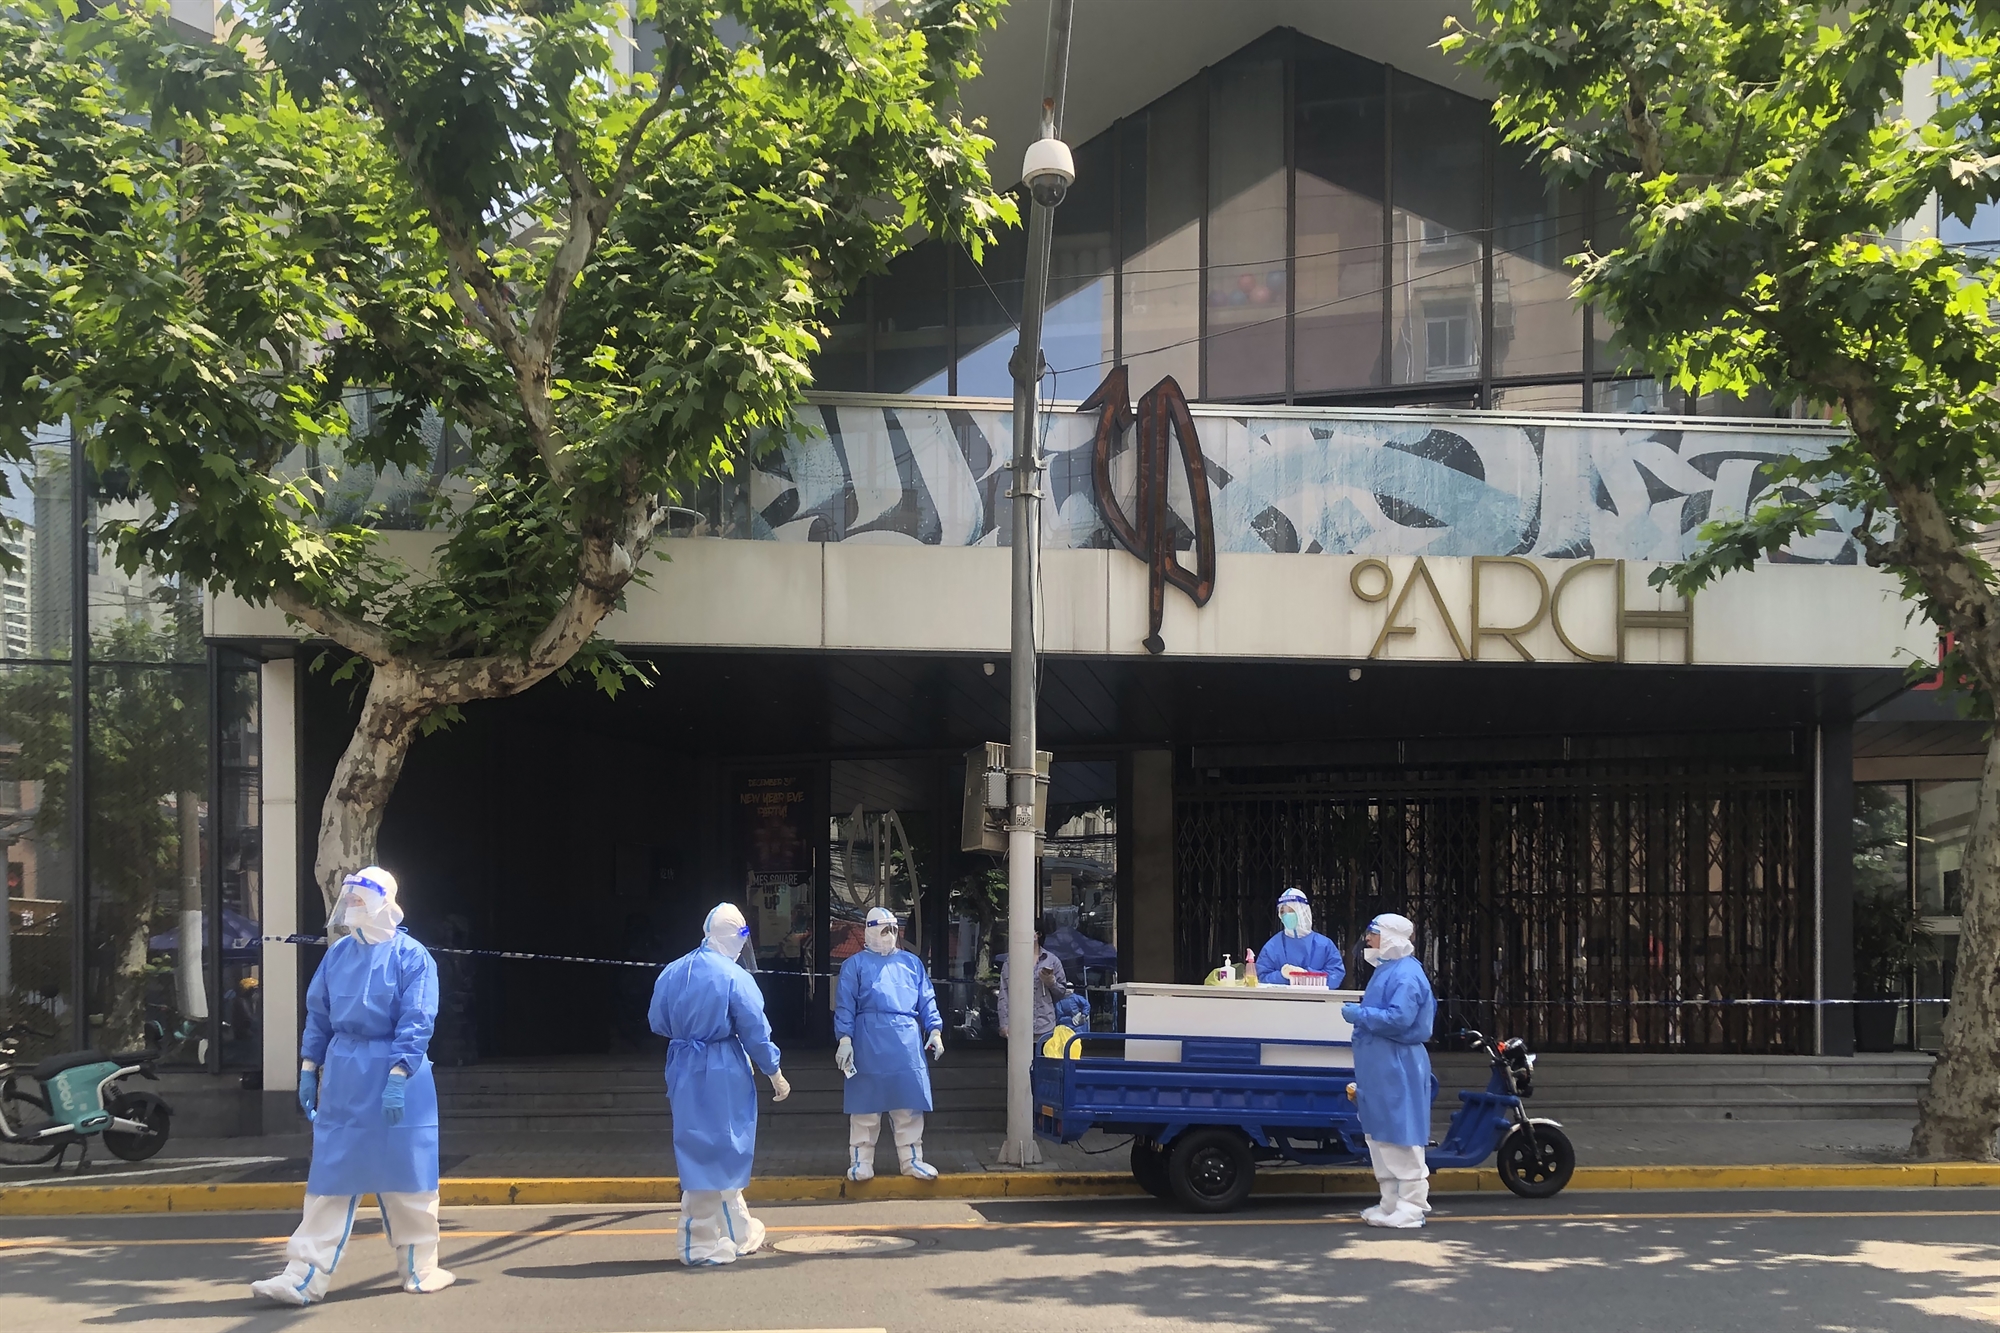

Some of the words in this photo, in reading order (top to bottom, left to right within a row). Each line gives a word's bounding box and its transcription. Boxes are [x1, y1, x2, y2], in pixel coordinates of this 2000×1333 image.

[748, 778, 783, 787] DECEMBER
[740, 793, 760, 804] NEW
[762, 792, 785, 806] YEAR
[786, 791, 805, 803] EVE
[753, 874, 768, 886] MES
[769, 874, 798, 885] SQUARE
[764, 894, 780, 910] UP
